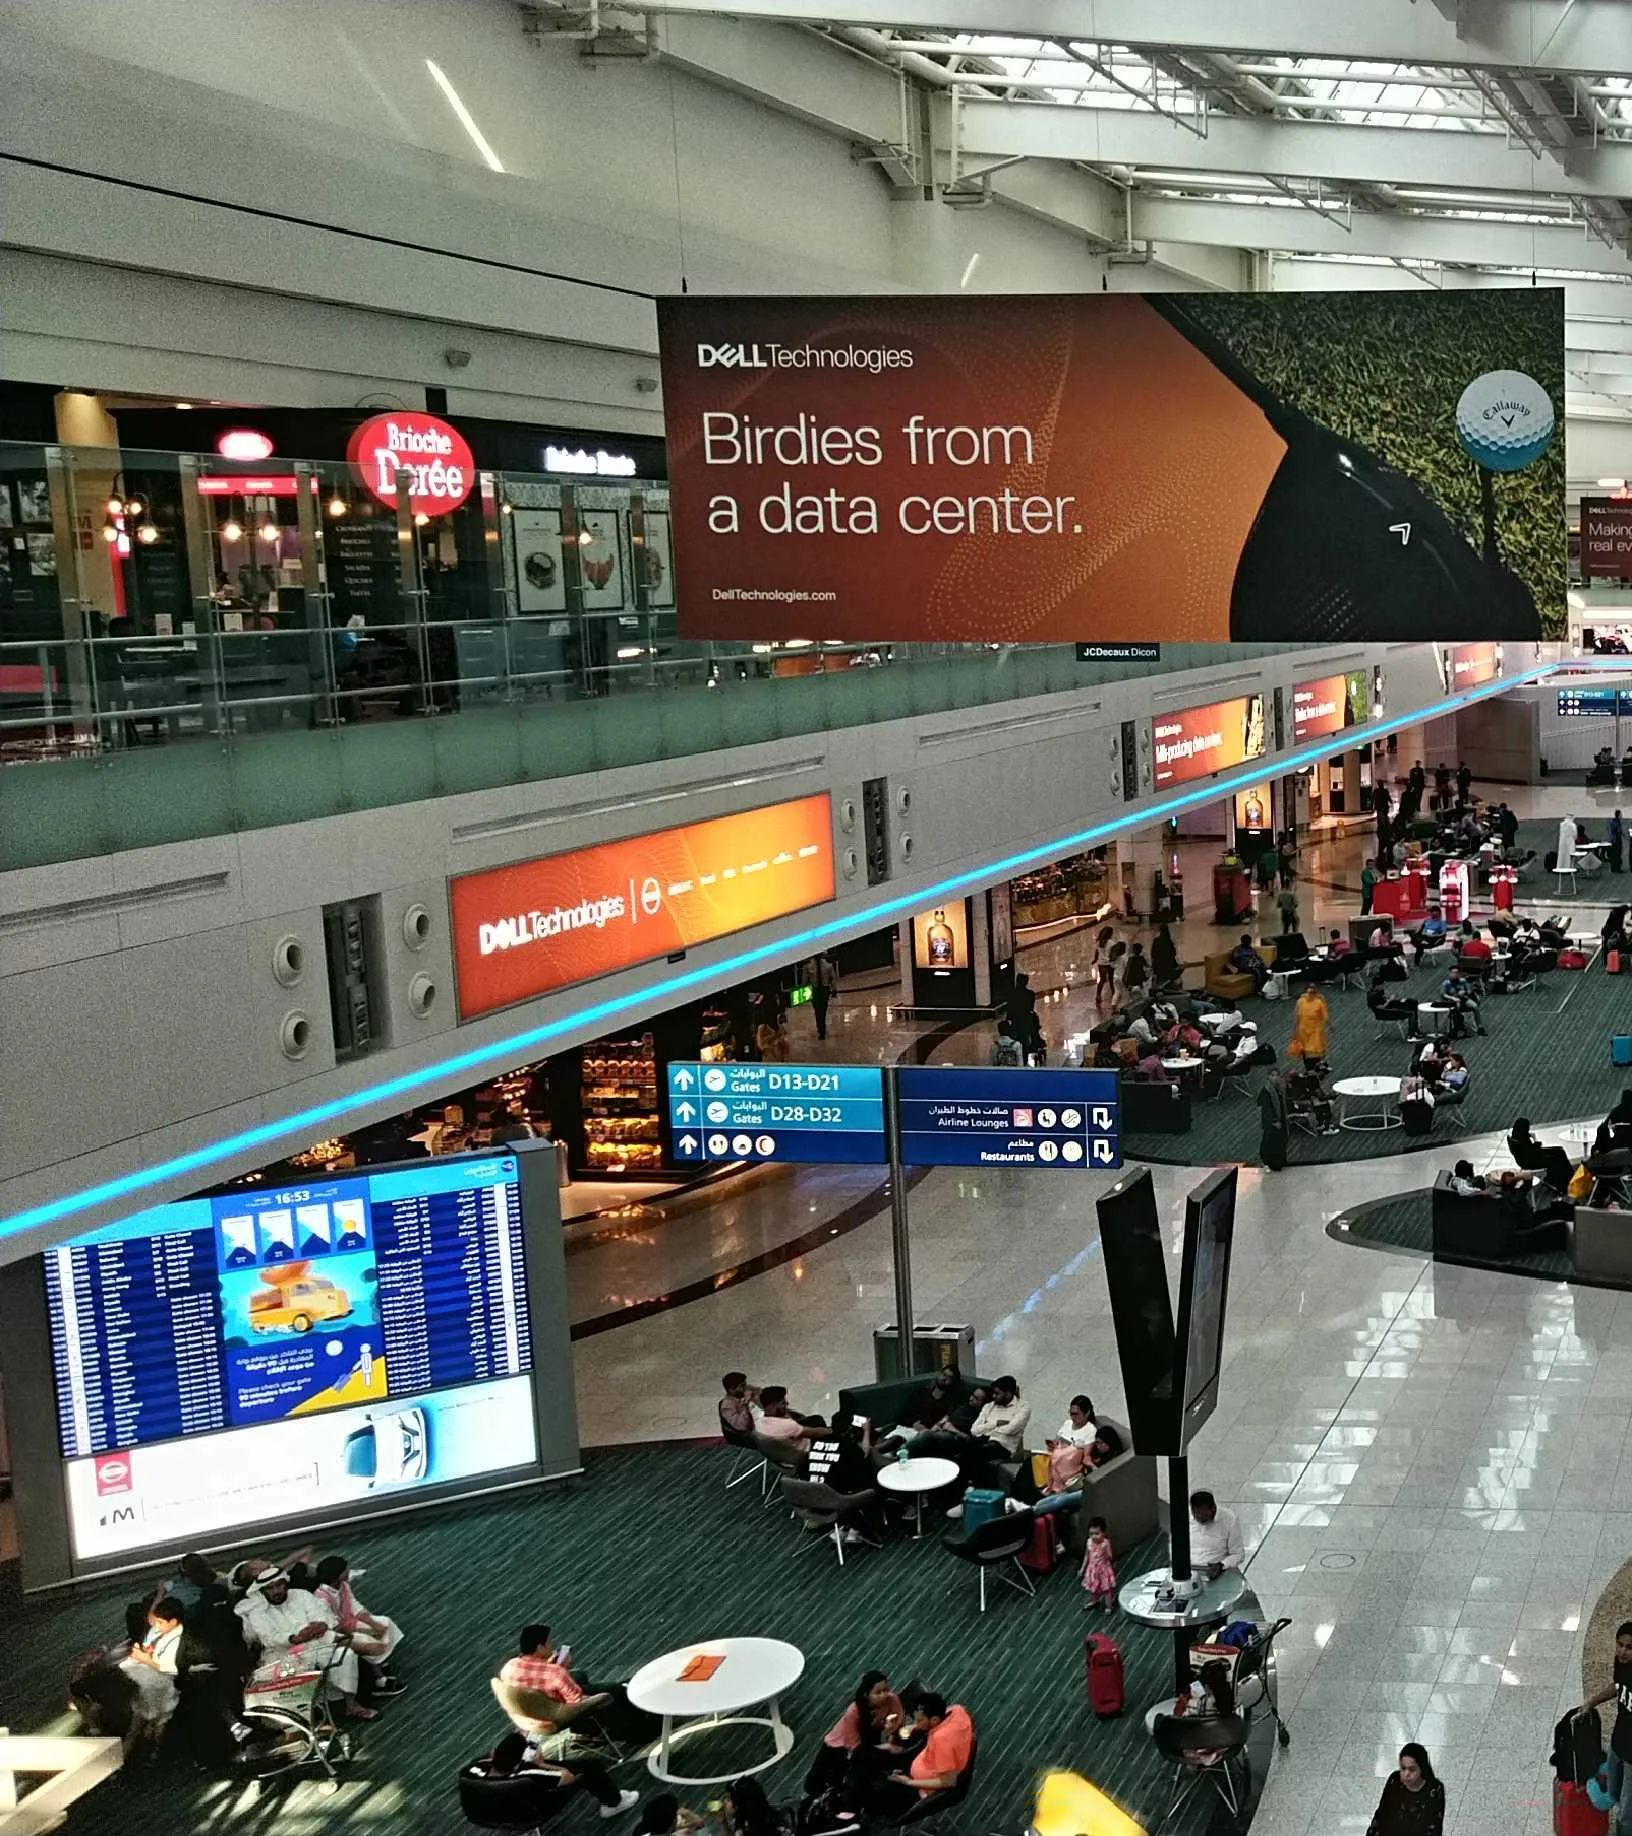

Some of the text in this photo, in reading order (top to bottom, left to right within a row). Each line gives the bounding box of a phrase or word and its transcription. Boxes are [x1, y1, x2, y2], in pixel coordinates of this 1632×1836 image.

[1482, 400, 1530, 420] Callaway
[386, 422, 453, 455] Brioche
[702, 412, 1033, 465] Birdies from
[708, 481, 1083, 535] a data center.
[1589, 539, 1613, 552] real
[712, 588, 836, 602] DellTechnologies.com
[1083, 648, 1157, 657] JCDecaux Dicon
[730, 1069, 766, 1080] البوابات
[731, 1073, 839, 1093] Gates D13-D21
[732, 1100, 767, 1112] البوابات
[733, 1106, 842, 1124] Gates D28-D32
[938, 1118, 1009, 1129] Airline Lounges
[980, 1152, 1035, 1161] Restaurants
[275, 1190, 310, 1204] 16:53
